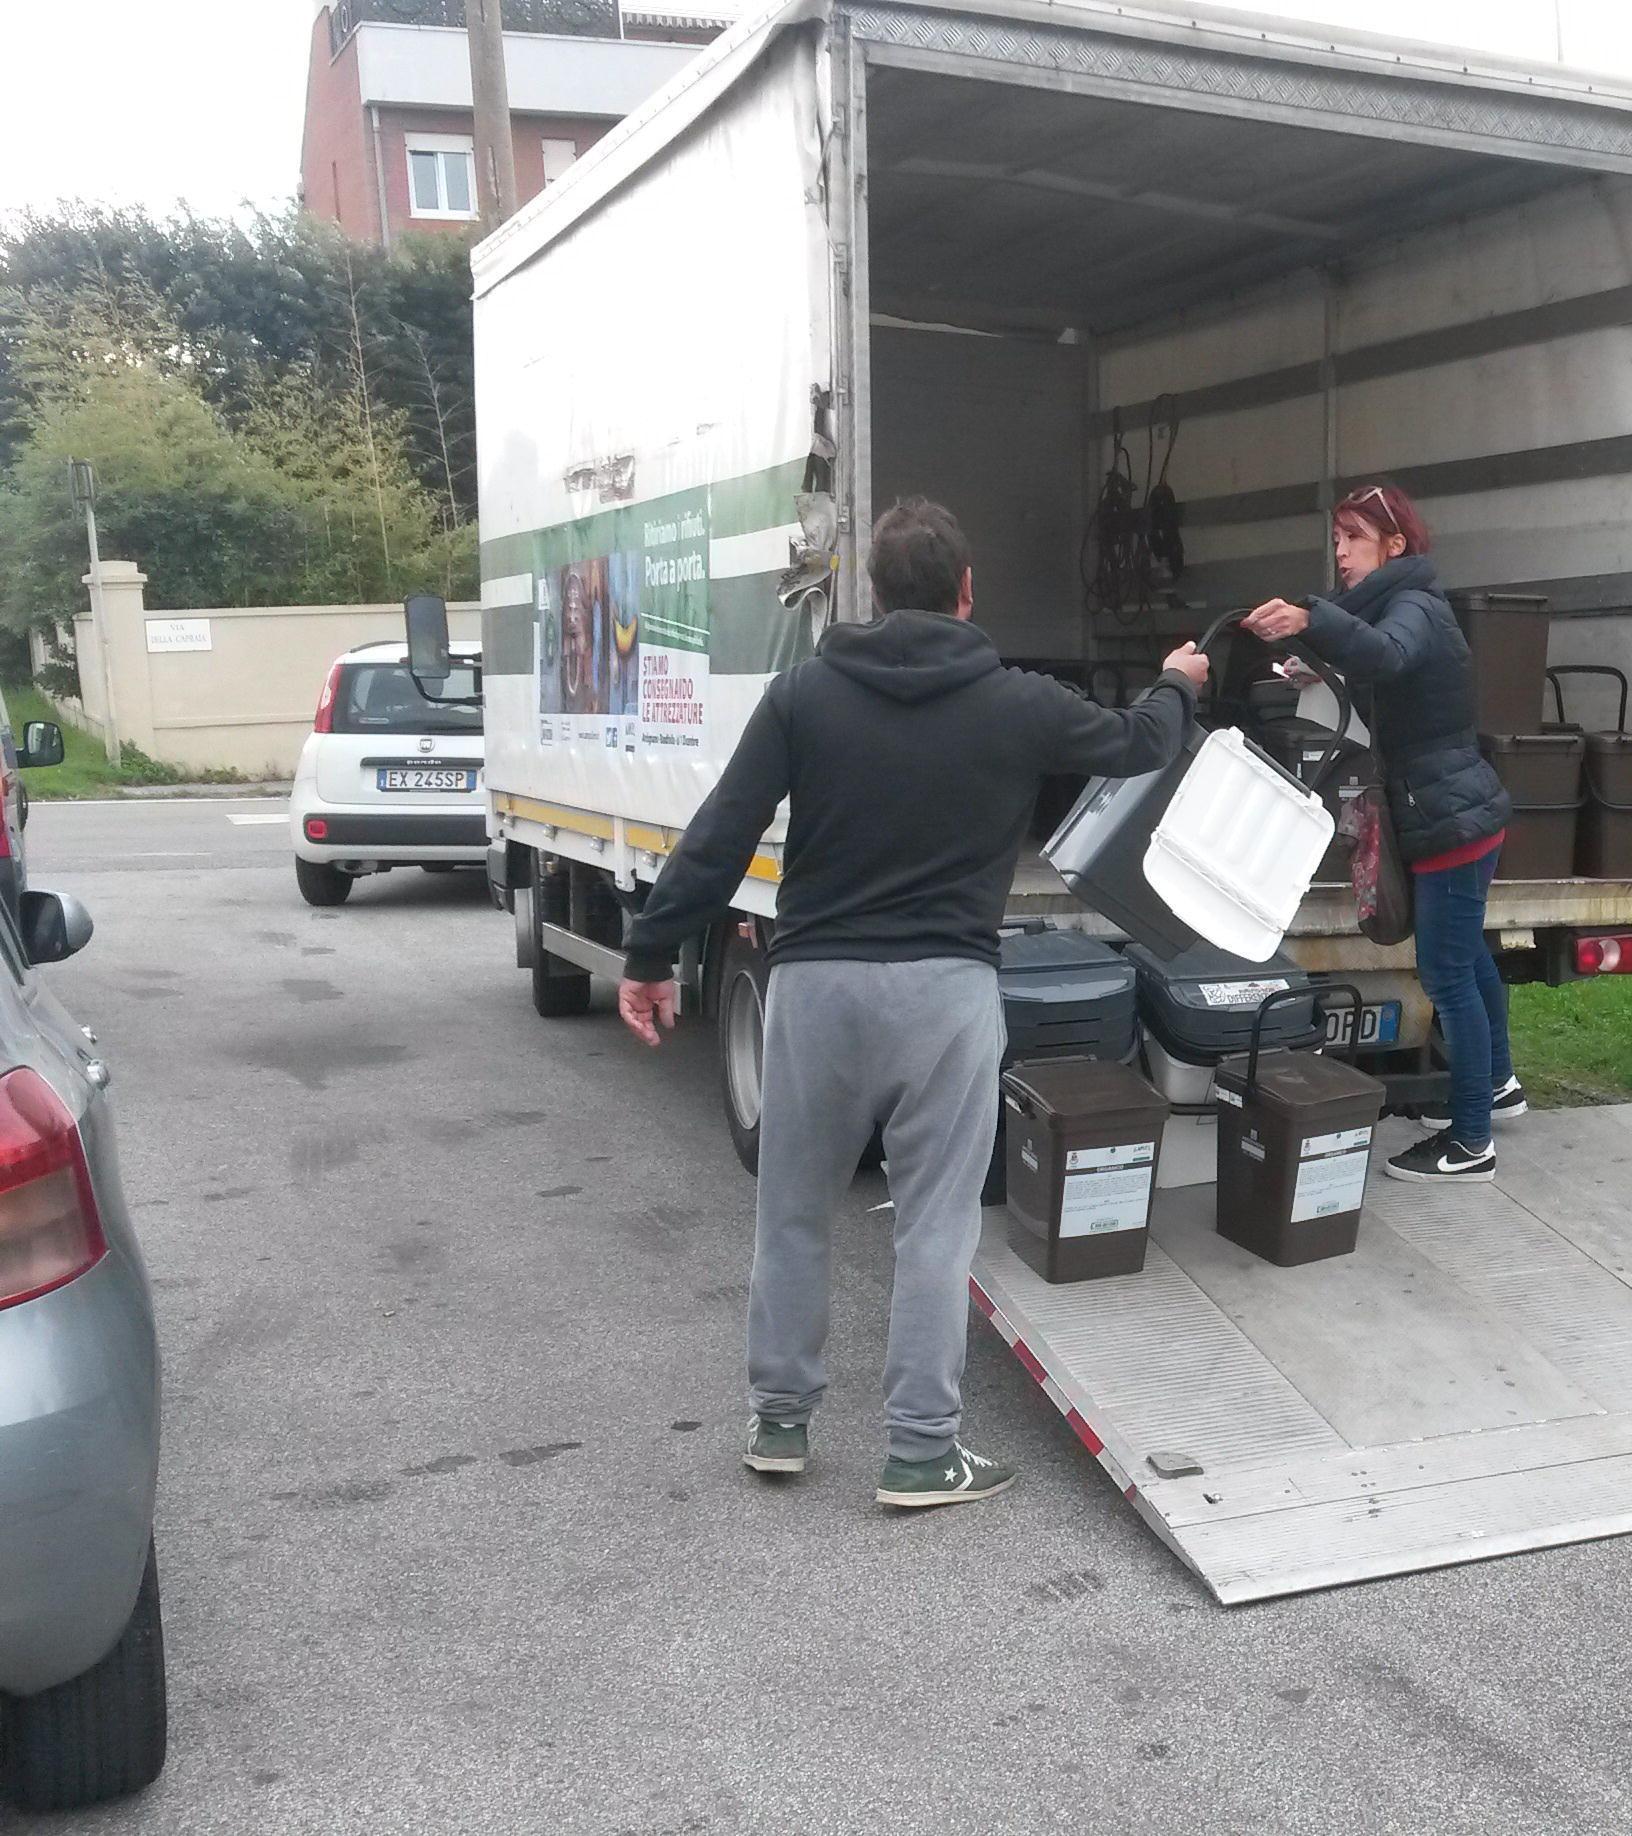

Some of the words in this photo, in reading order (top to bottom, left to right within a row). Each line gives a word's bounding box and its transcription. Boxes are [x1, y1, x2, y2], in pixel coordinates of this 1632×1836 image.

[645, 555, 668, 588] Porta
[669, 559, 676, 584] a
[643, 655, 669, 676] STIAMO
[643, 678, 694, 700] CONSEGNANDO
[642, 702, 650, 723] LE
[652, 702, 704, 725] ATTREZZATURE
[389, 771, 408, 787] EX
[414, 772, 464, 787] 245SP
